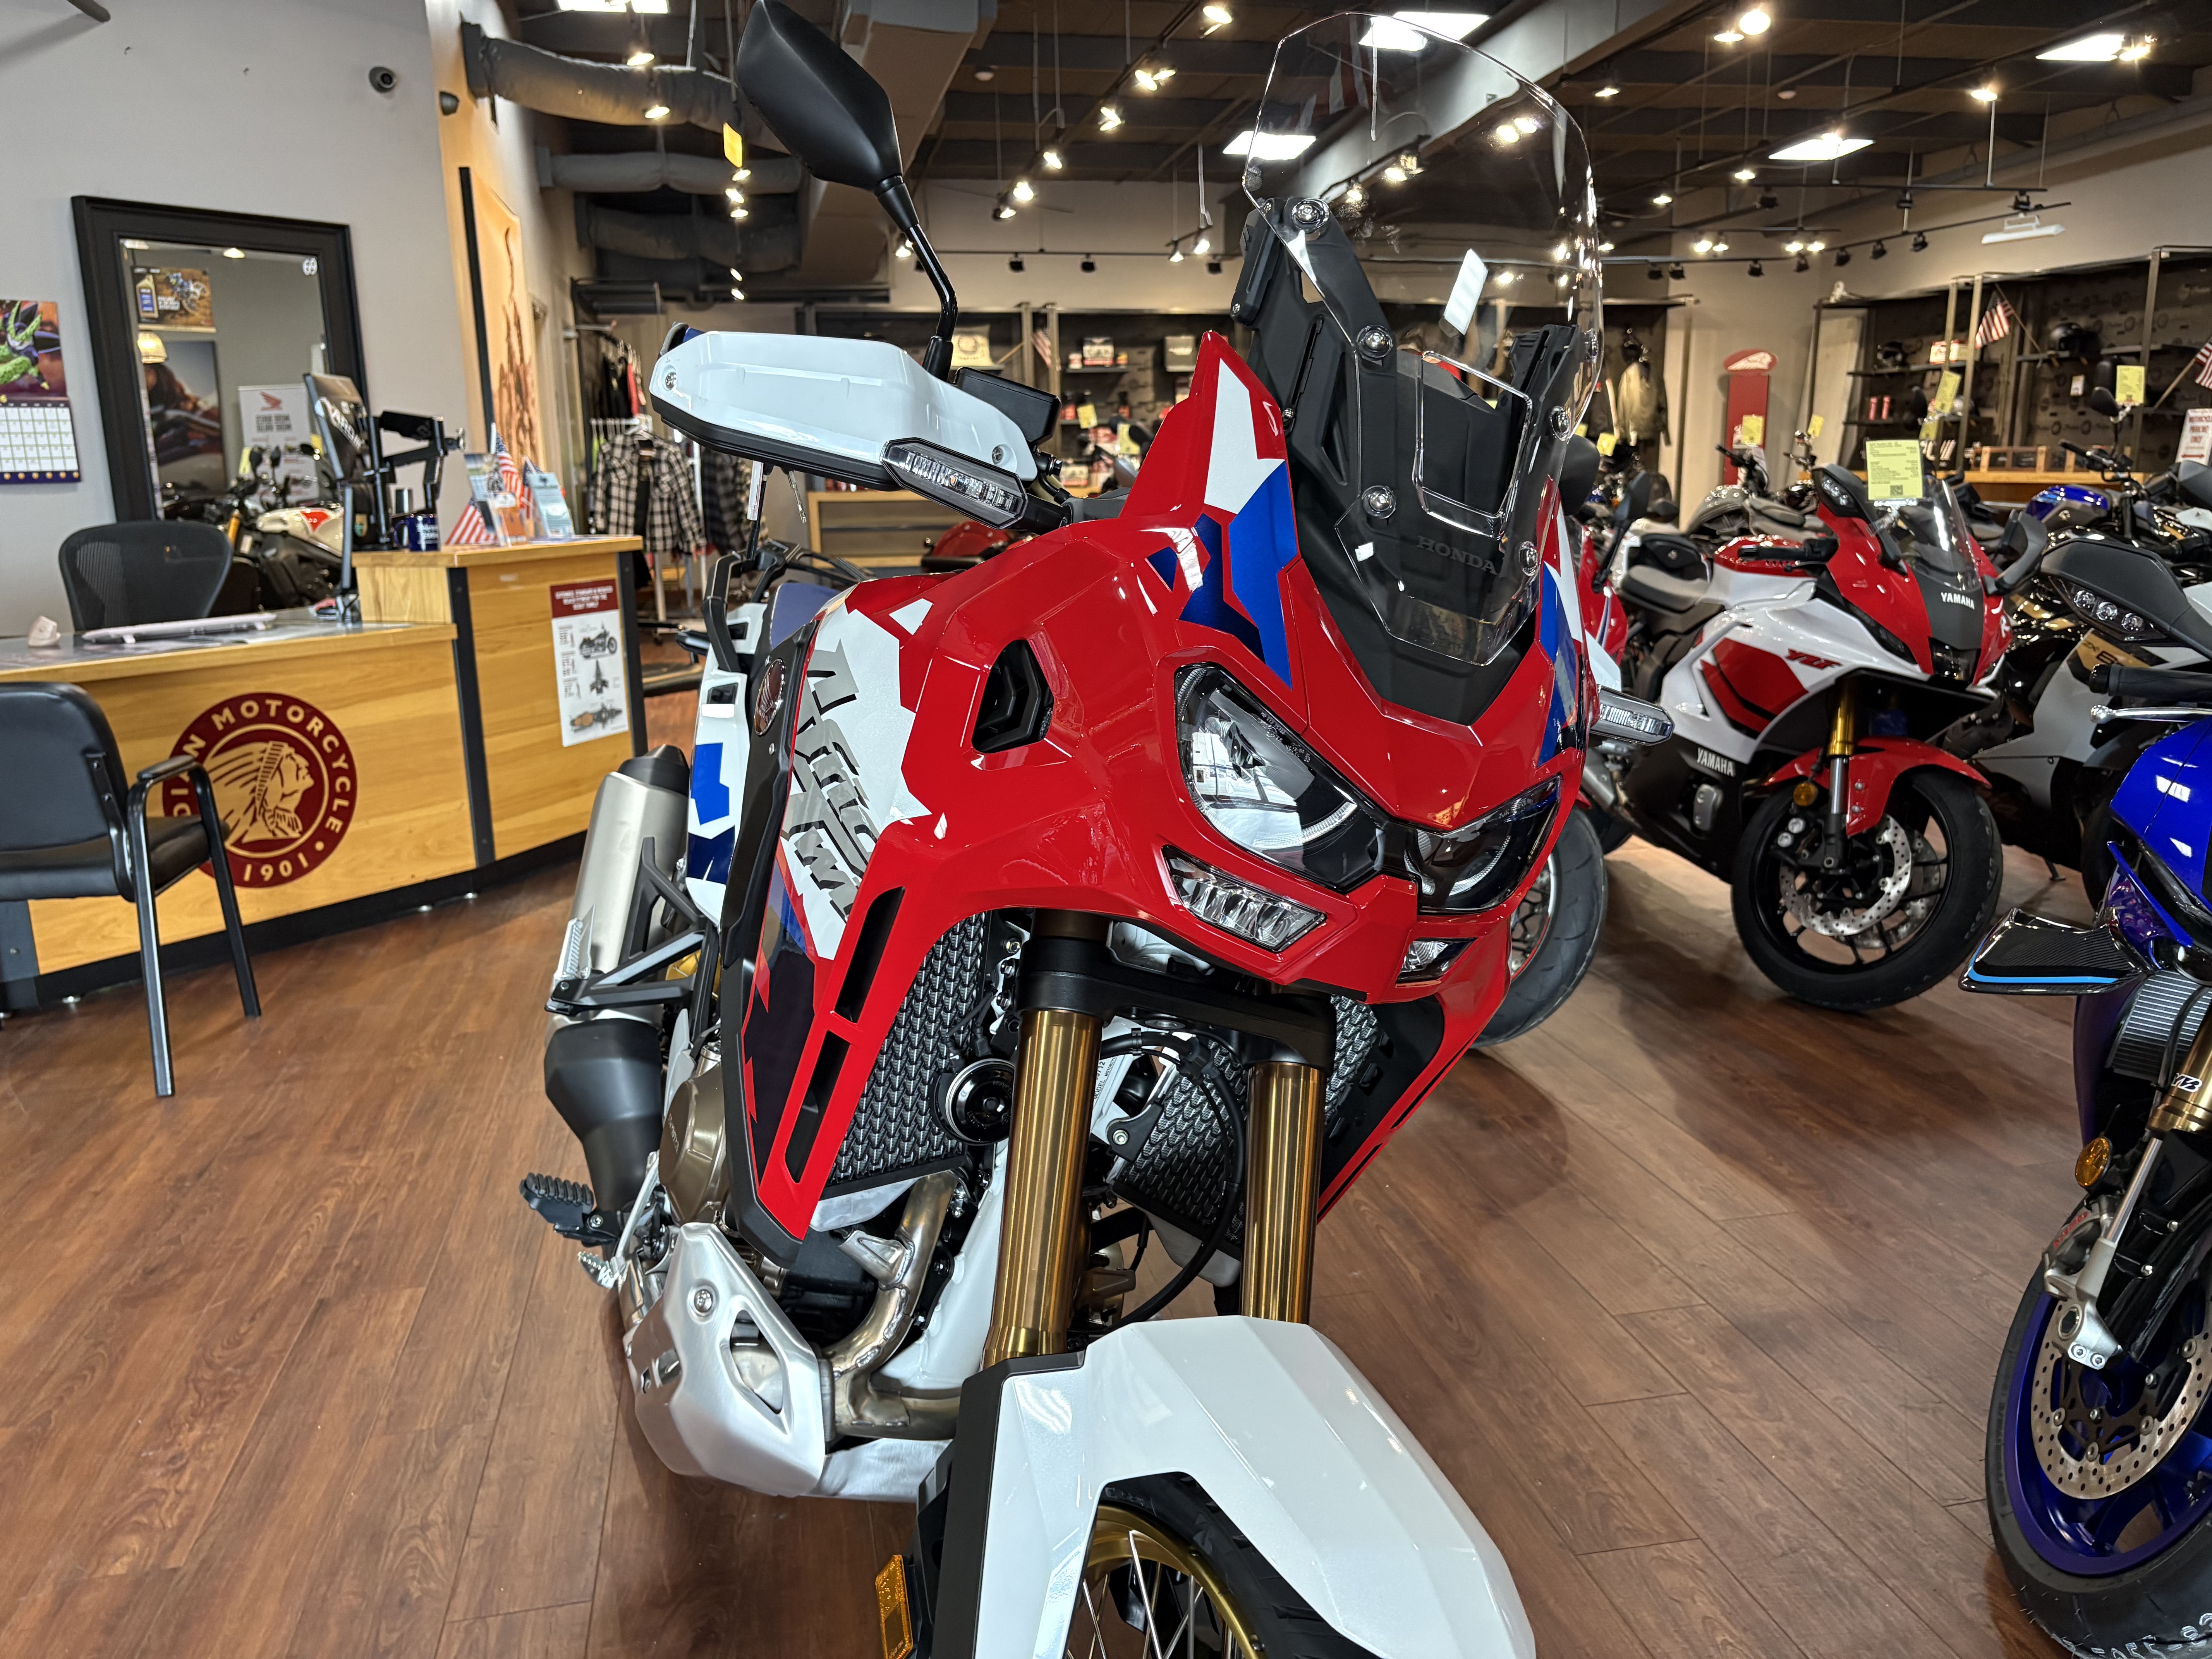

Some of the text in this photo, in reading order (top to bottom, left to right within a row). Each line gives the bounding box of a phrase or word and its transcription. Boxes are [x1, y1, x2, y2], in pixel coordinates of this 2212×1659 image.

[1416, 535, 1498, 575] HONDA
[1940, 592, 1975, 610] YAMAHA
[211, 699, 351, 834] MOTORCYCLE
[1697, 747, 1735, 777] YAMAHA
[244, 853, 308, 882] 1901
